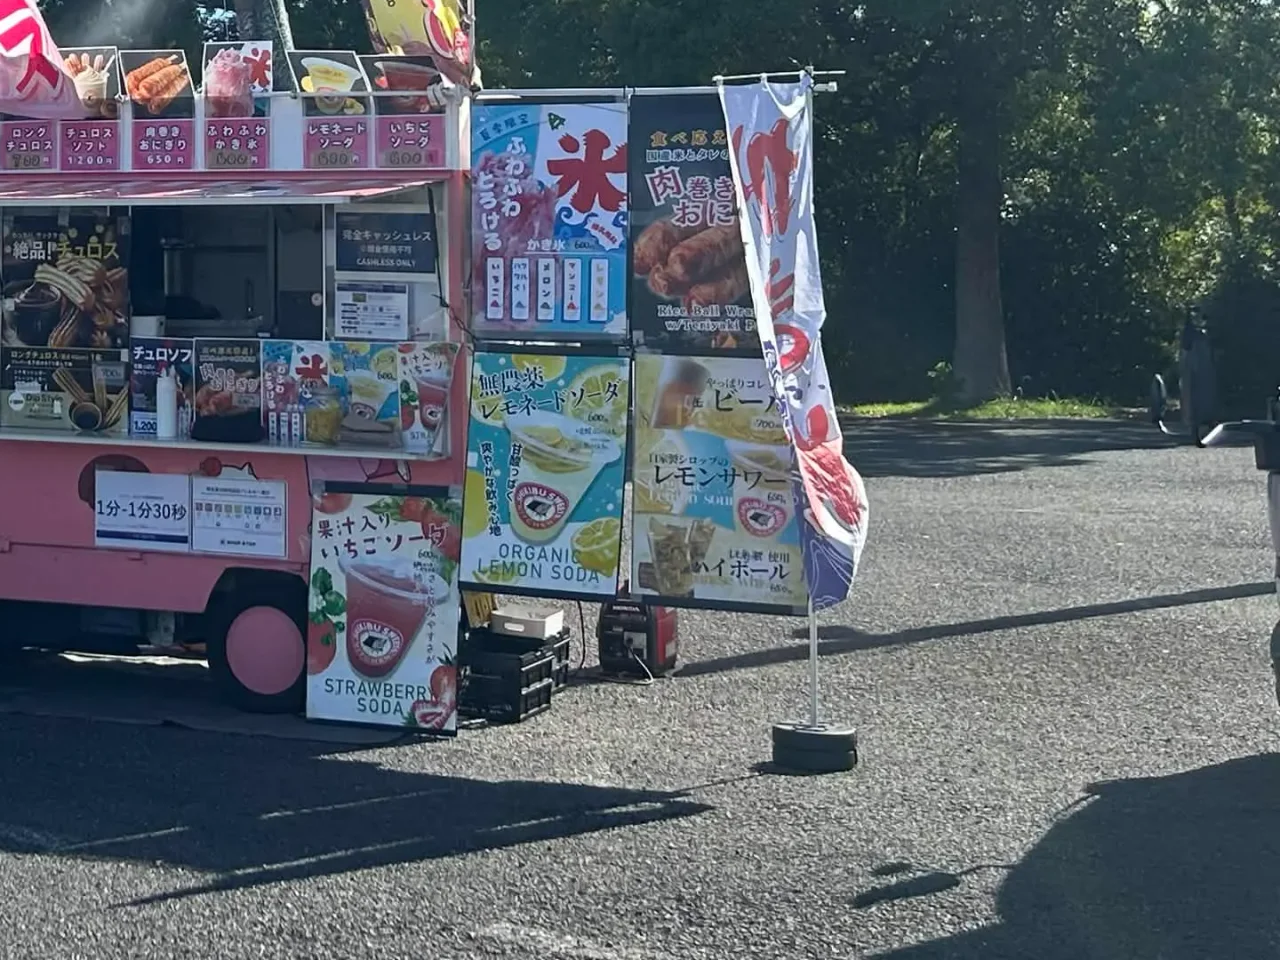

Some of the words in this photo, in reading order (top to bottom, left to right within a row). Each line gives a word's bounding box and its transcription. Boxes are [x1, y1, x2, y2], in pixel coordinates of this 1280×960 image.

[12, 127, 47, 138] ロング
[67, 127, 113, 138] チュロス
[145, 126, 181, 137] 肉巻き
[207, 125, 267, 136] ふわふわ
[308, 124, 366, 135] レモネード
[389, 122, 431, 134] いちご
[6, 141, 53, 151] チュロス
[72, 141, 107, 152] ソフト
[139, 140, 187, 151] おにぎり
[215, 139, 258, 150] かき氷
[319, 137, 355, 148] ソーダ
[391, 136, 430, 149] ソーダ
[67, 156, 113, 165] 1200円
[147, 154, 184, 164] 650円
[388, 151, 429, 165] 600
[502, 137, 527, 217] ふわふわ
[546, 128, 628, 214] 氷
[644, 164, 736, 207] 肉巻き
[478, 171, 503, 251] とろける
[671, 200, 735, 228] おに
[342, 229, 432, 241] 完全キャッシュレス
[526, 238, 566, 251] かき氷
[397, 259, 417, 268] ONLY
[542, 262, 552, 298] メロン
[658, 304, 689, 318] Rice
[694, 305, 721, 318] Ball
[726, 305, 756, 319] Wra
[133, 346, 192, 362] チュロソフ
[402, 360, 445, 378] いちごソ
[478, 366, 545, 398] 無農薬
[705, 377, 764, 389] やっぱりコレ
[480, 379, 620, 419] レモネードソーダ
[506, 443, 523, 502] 甘酸っぱく
[654, 465, 787, 490] レモンサワー
[480, 443, 502, 537] 爽やかな飲み心地
[97, 500, 188, 521] 1分-1分30秒
[318, 514, 391, 539] 果汁入り
[321, 524, 448, 559] いちごソーダ
[478, 558, 542, 578] LEMON
[551, 565, 600, 583] SODA
[692, 558, 790, 581] ハイボール
[356, 696, 405, 716] SODA
